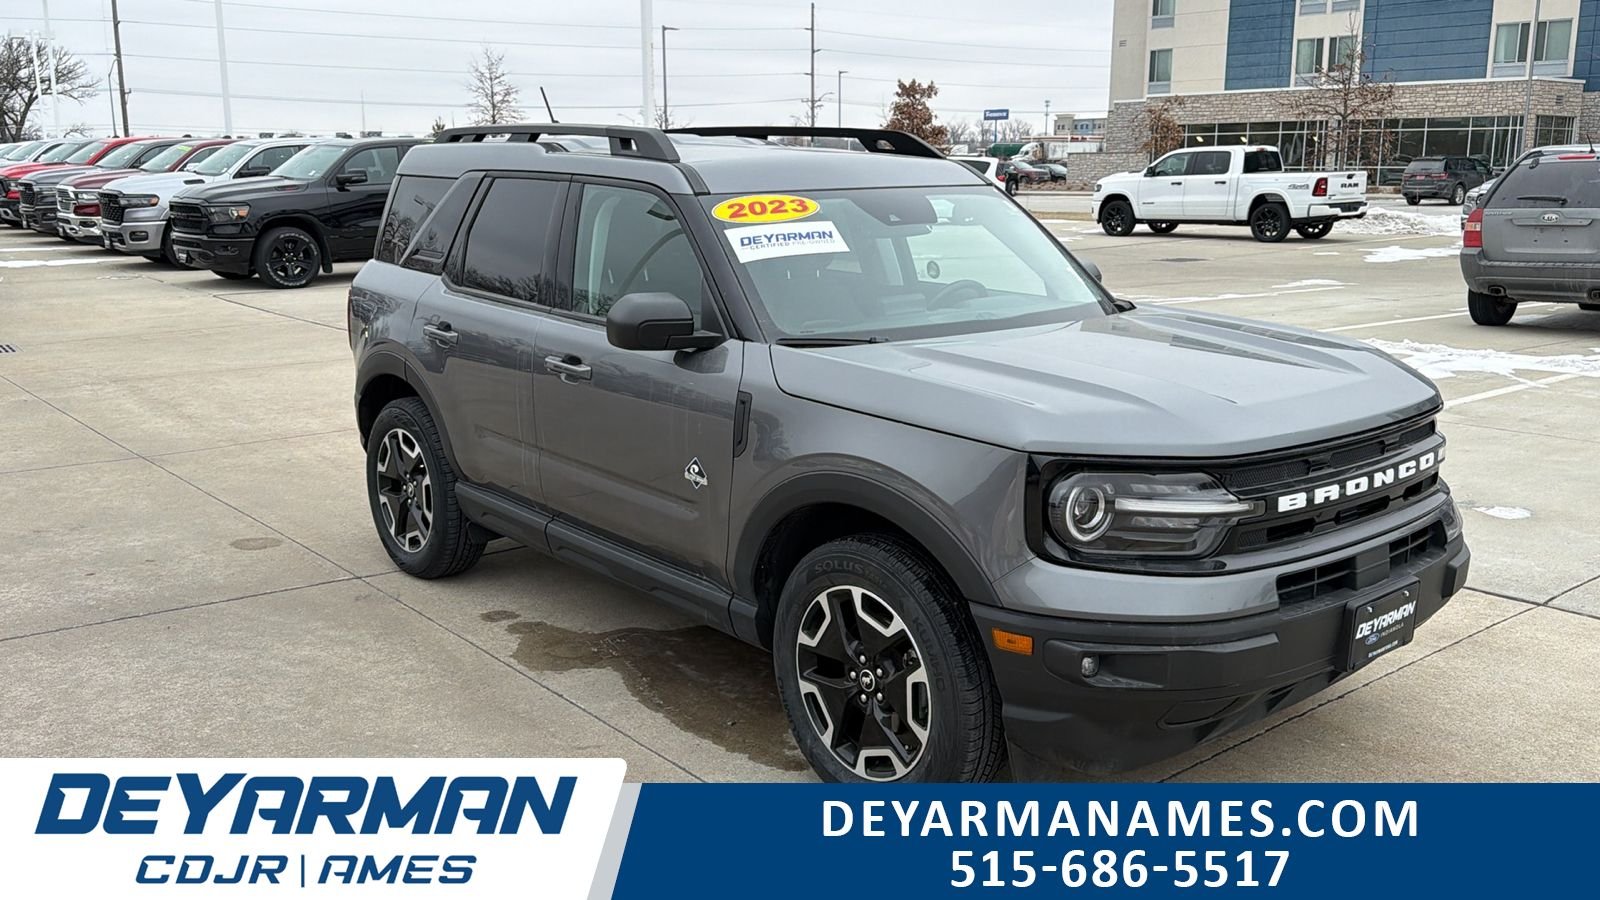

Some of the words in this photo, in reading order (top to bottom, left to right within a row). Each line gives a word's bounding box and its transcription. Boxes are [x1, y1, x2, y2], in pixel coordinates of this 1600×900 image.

[727, 198, 810, 219] 2023
[740, 230, 833, 247] DEYARMAN
[750, 241, 790, 251] CERTIFIED
[1277, 451, 1435, 513] BRONCO
[815, 560, 865, 575] SOLUS
[1355, 600, 1417, 640] DEYARMAN
